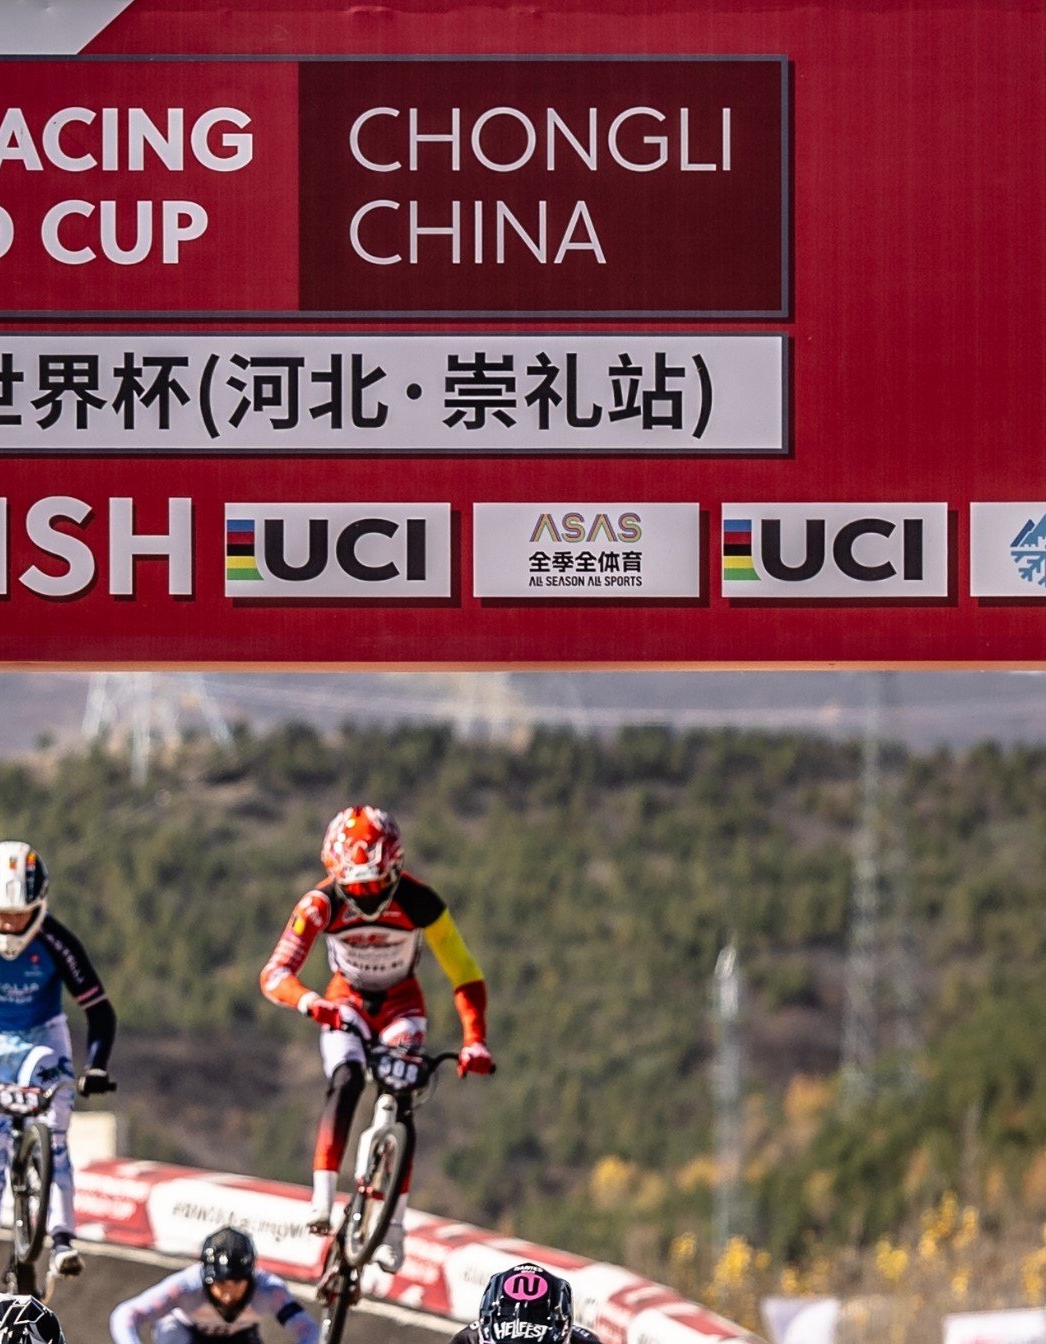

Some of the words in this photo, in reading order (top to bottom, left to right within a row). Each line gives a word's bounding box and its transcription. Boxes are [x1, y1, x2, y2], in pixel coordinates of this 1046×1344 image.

[350, 107, 732, 173] CHONGLI
[41, 199, 210, 265] CUP
[350, 200, 608, 266] CHINA
[264, 518, 427, 582] UCI
[529, 512, 643, 543] ASAS
[761, 518, 924, 582] UCI
[528, 550, 643, 573] 全季全体育
[529, 575, 544, 587] ALL
[545, 575, 585, 587] SEASON
[587, 575, 602, 587] ALL
[604, 575, 643, 587] SPORTS
[493, 1318, 553, 1343] HELLFEST
